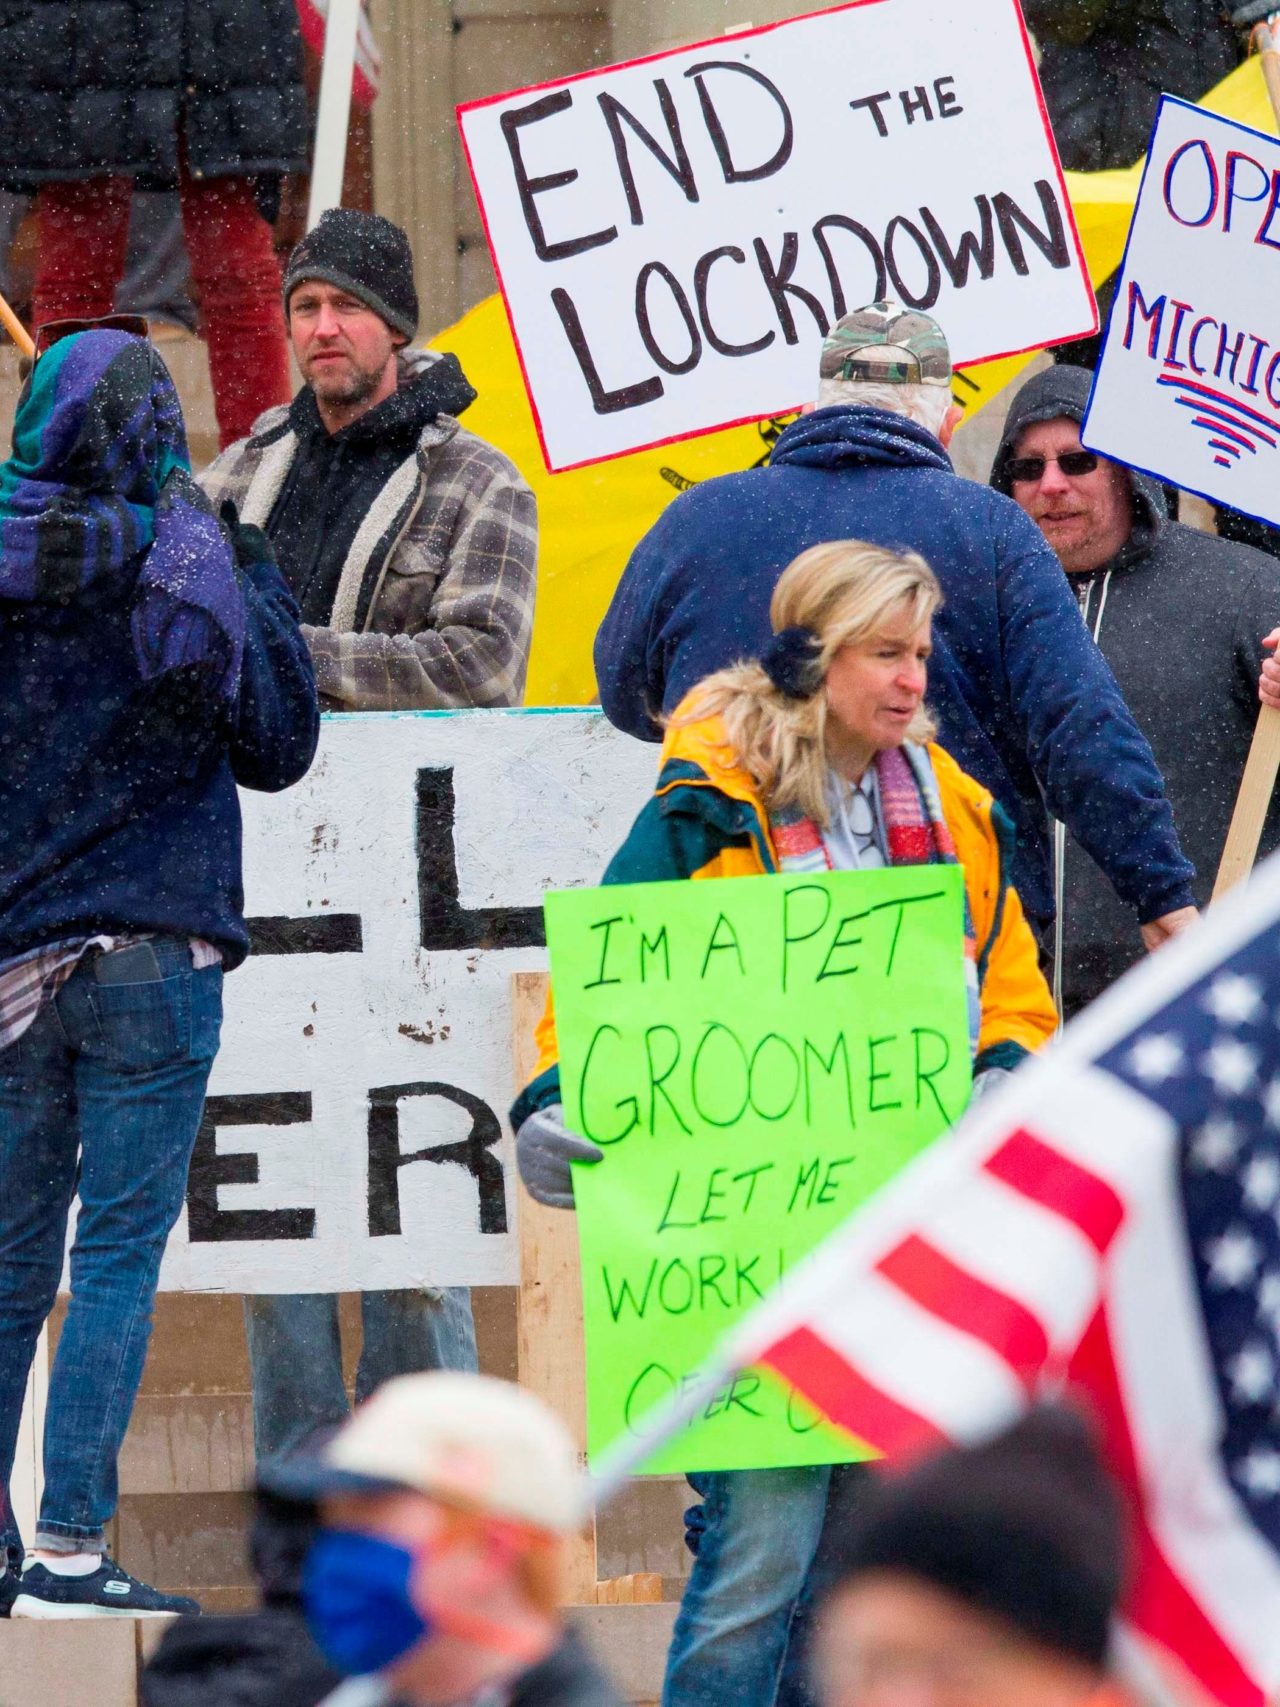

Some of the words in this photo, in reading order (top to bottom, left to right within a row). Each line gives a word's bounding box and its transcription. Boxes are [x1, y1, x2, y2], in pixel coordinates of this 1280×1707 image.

[500, 60, 793, 262] END
[849, 75, 964, 137] THE
[550, 178, 1073, 415] LOCKDOWN
[582, 913, 670, 990] I'M
[701, 911, 747, 978] A
[783, 884, 946, 994] PET
[579, 1021, 956, 1146] GROOMER
[657, 1161, 776, 1235] LET
[787, 1156, 857, 1214] ME
[602, 1253, 765, 1323] WORK
